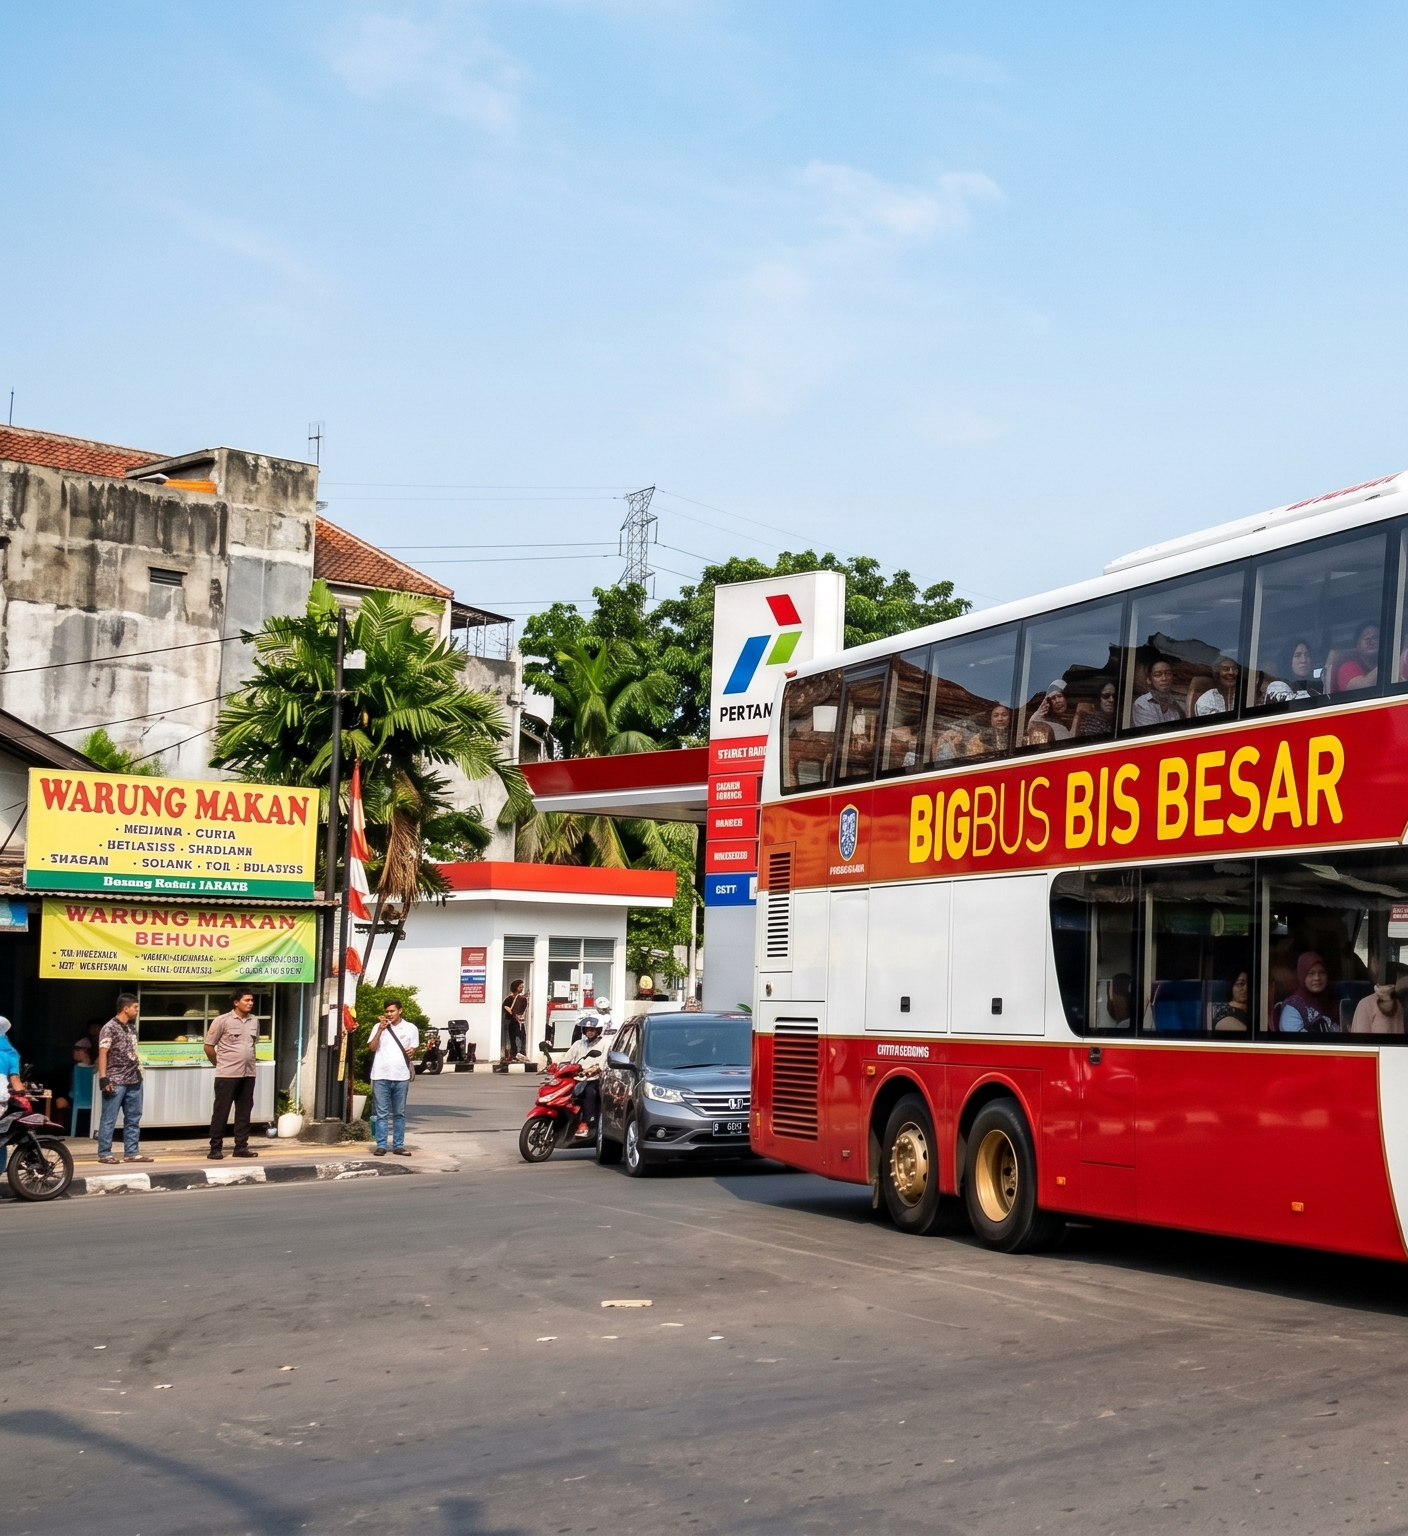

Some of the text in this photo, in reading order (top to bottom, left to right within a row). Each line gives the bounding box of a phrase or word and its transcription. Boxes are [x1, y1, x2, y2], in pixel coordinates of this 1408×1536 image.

[40, 778, 309, 826] WARUNG MAKAN
[1065, 763, 1141, 849] BIS
[1157, 734, 1345, 841] BESAR
[196, 829, 236, 840] CURIA
[142, 858, 192, 870] SOLANK
[64, 905, 297, 930] WARUNG MAKAN
[135, 931, 230, 948] BEHUNG
